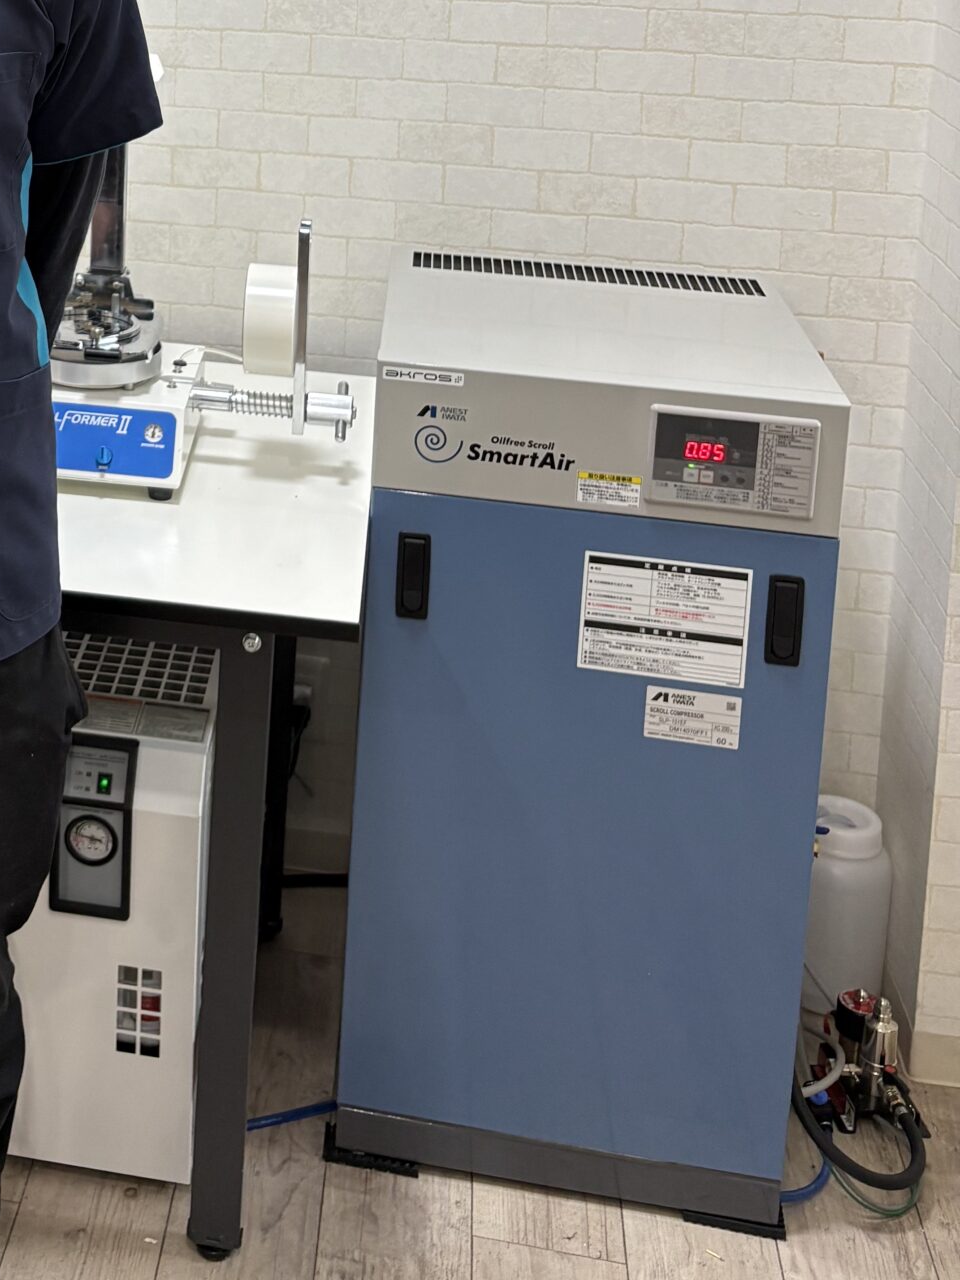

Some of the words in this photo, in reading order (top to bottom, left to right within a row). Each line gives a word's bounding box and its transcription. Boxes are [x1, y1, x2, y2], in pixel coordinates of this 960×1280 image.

[440, 405, 469, 417] ANEST
[442, 413, 467, 422] IWATA
[490, 435, 526, 449] Oilfree
[527, 439, 555, 452] Scroll
[684, 440, 727, 462] 0.85
[466, 443, 576, 472] SmartAir
[671, 693, 697, 702] ANEST
[672, 699, 696, 707] IWATA
[649, 706, 670, 716] SCROLL
[669, 709, 705, 719] COMPRESSOR
